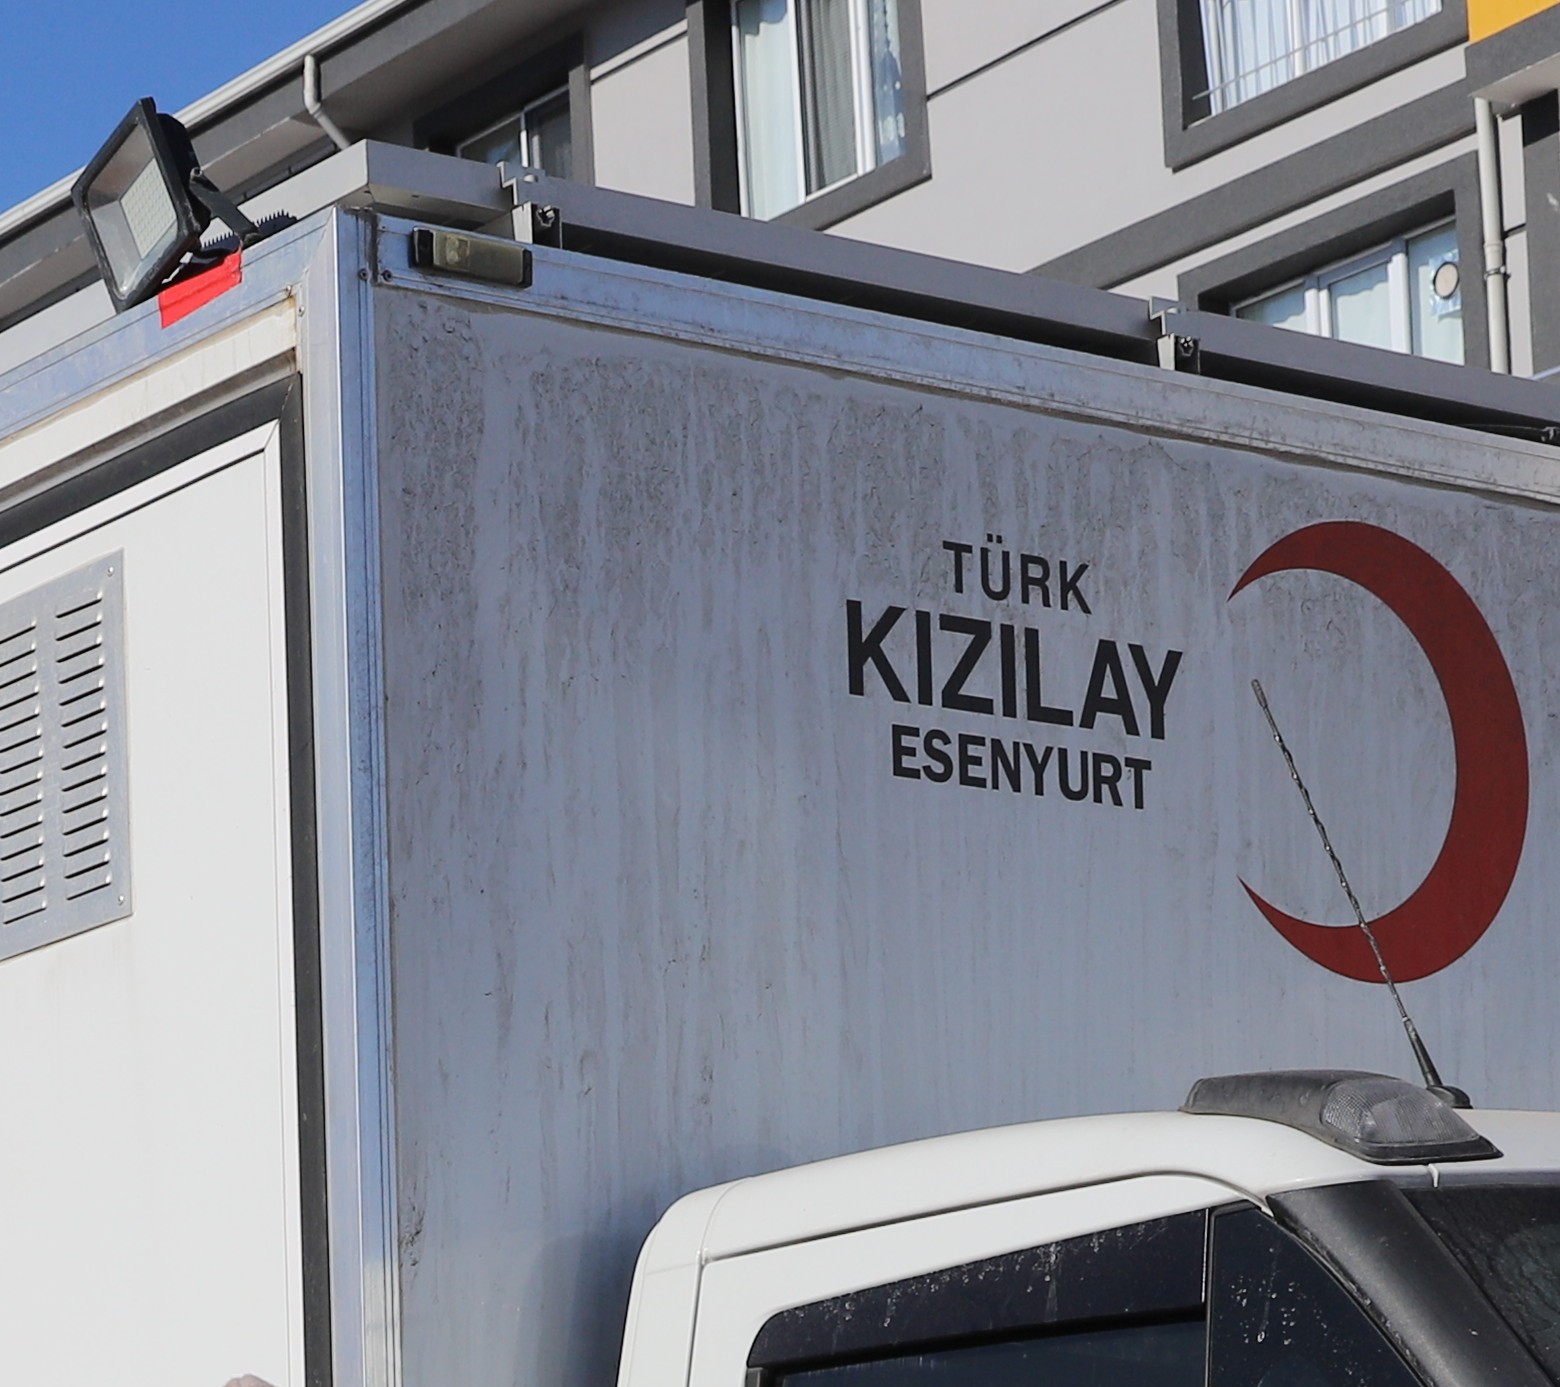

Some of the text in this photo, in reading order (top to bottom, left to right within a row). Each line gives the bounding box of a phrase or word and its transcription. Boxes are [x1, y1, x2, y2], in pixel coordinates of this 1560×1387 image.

[942, 533, 1091, 615] TÜRK
[846, 599, 1183, 740] KIZILAY
[891, 724, 1151, 810] ESENYURT
